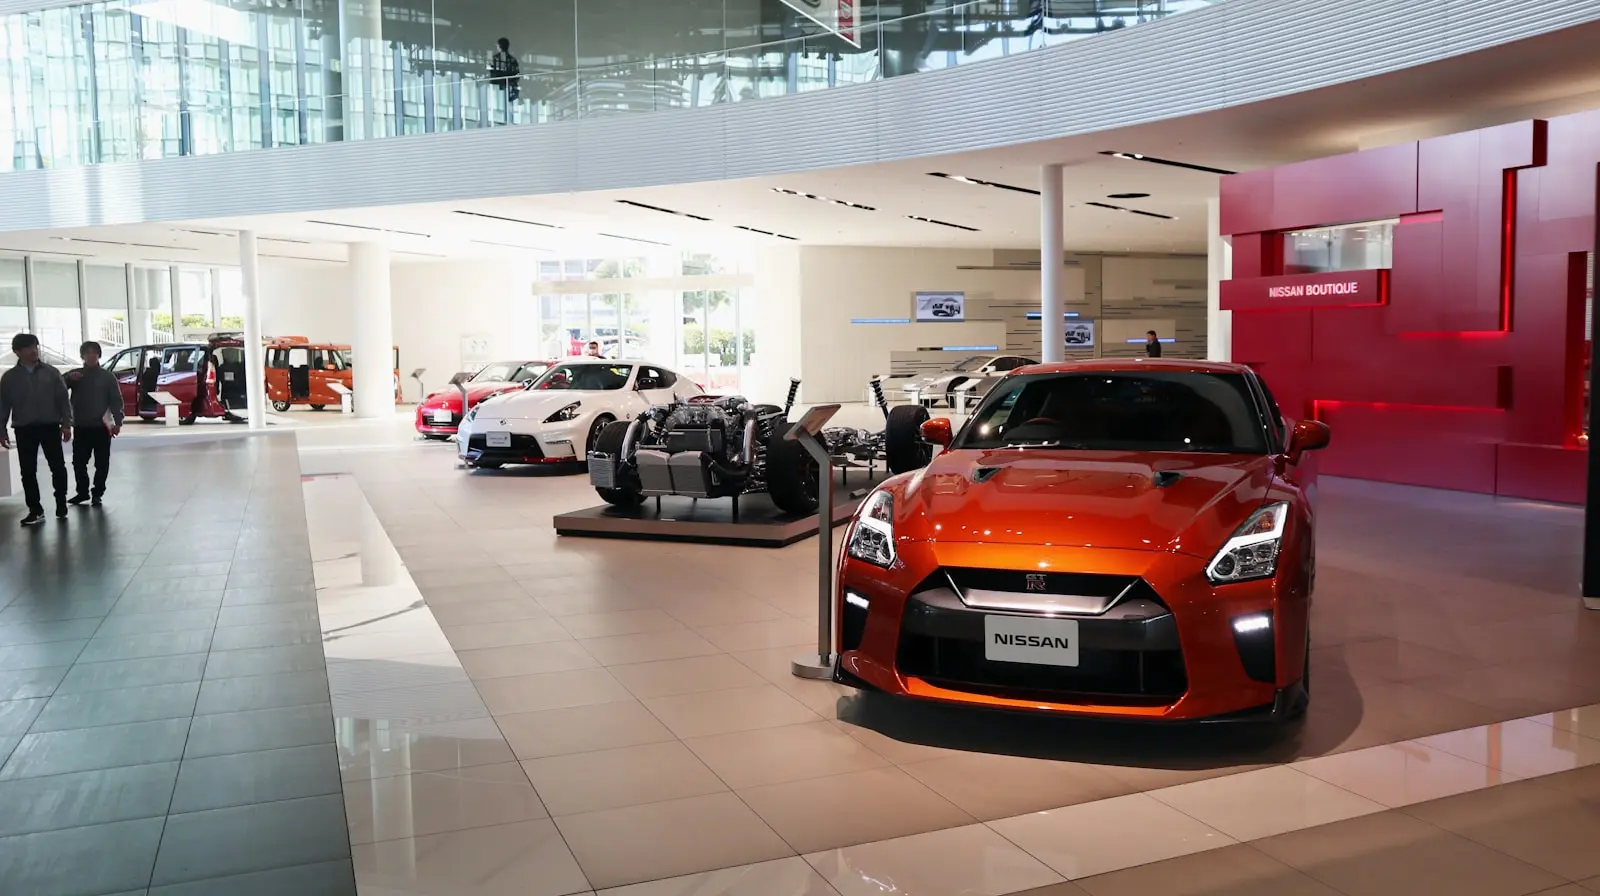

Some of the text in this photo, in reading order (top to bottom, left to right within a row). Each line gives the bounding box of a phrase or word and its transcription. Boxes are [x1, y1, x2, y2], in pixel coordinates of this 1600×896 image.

[1269, 281, 1358, 298] NISSAN BOUTIQUE
[994, 633, 1069, 649] NISSAN
